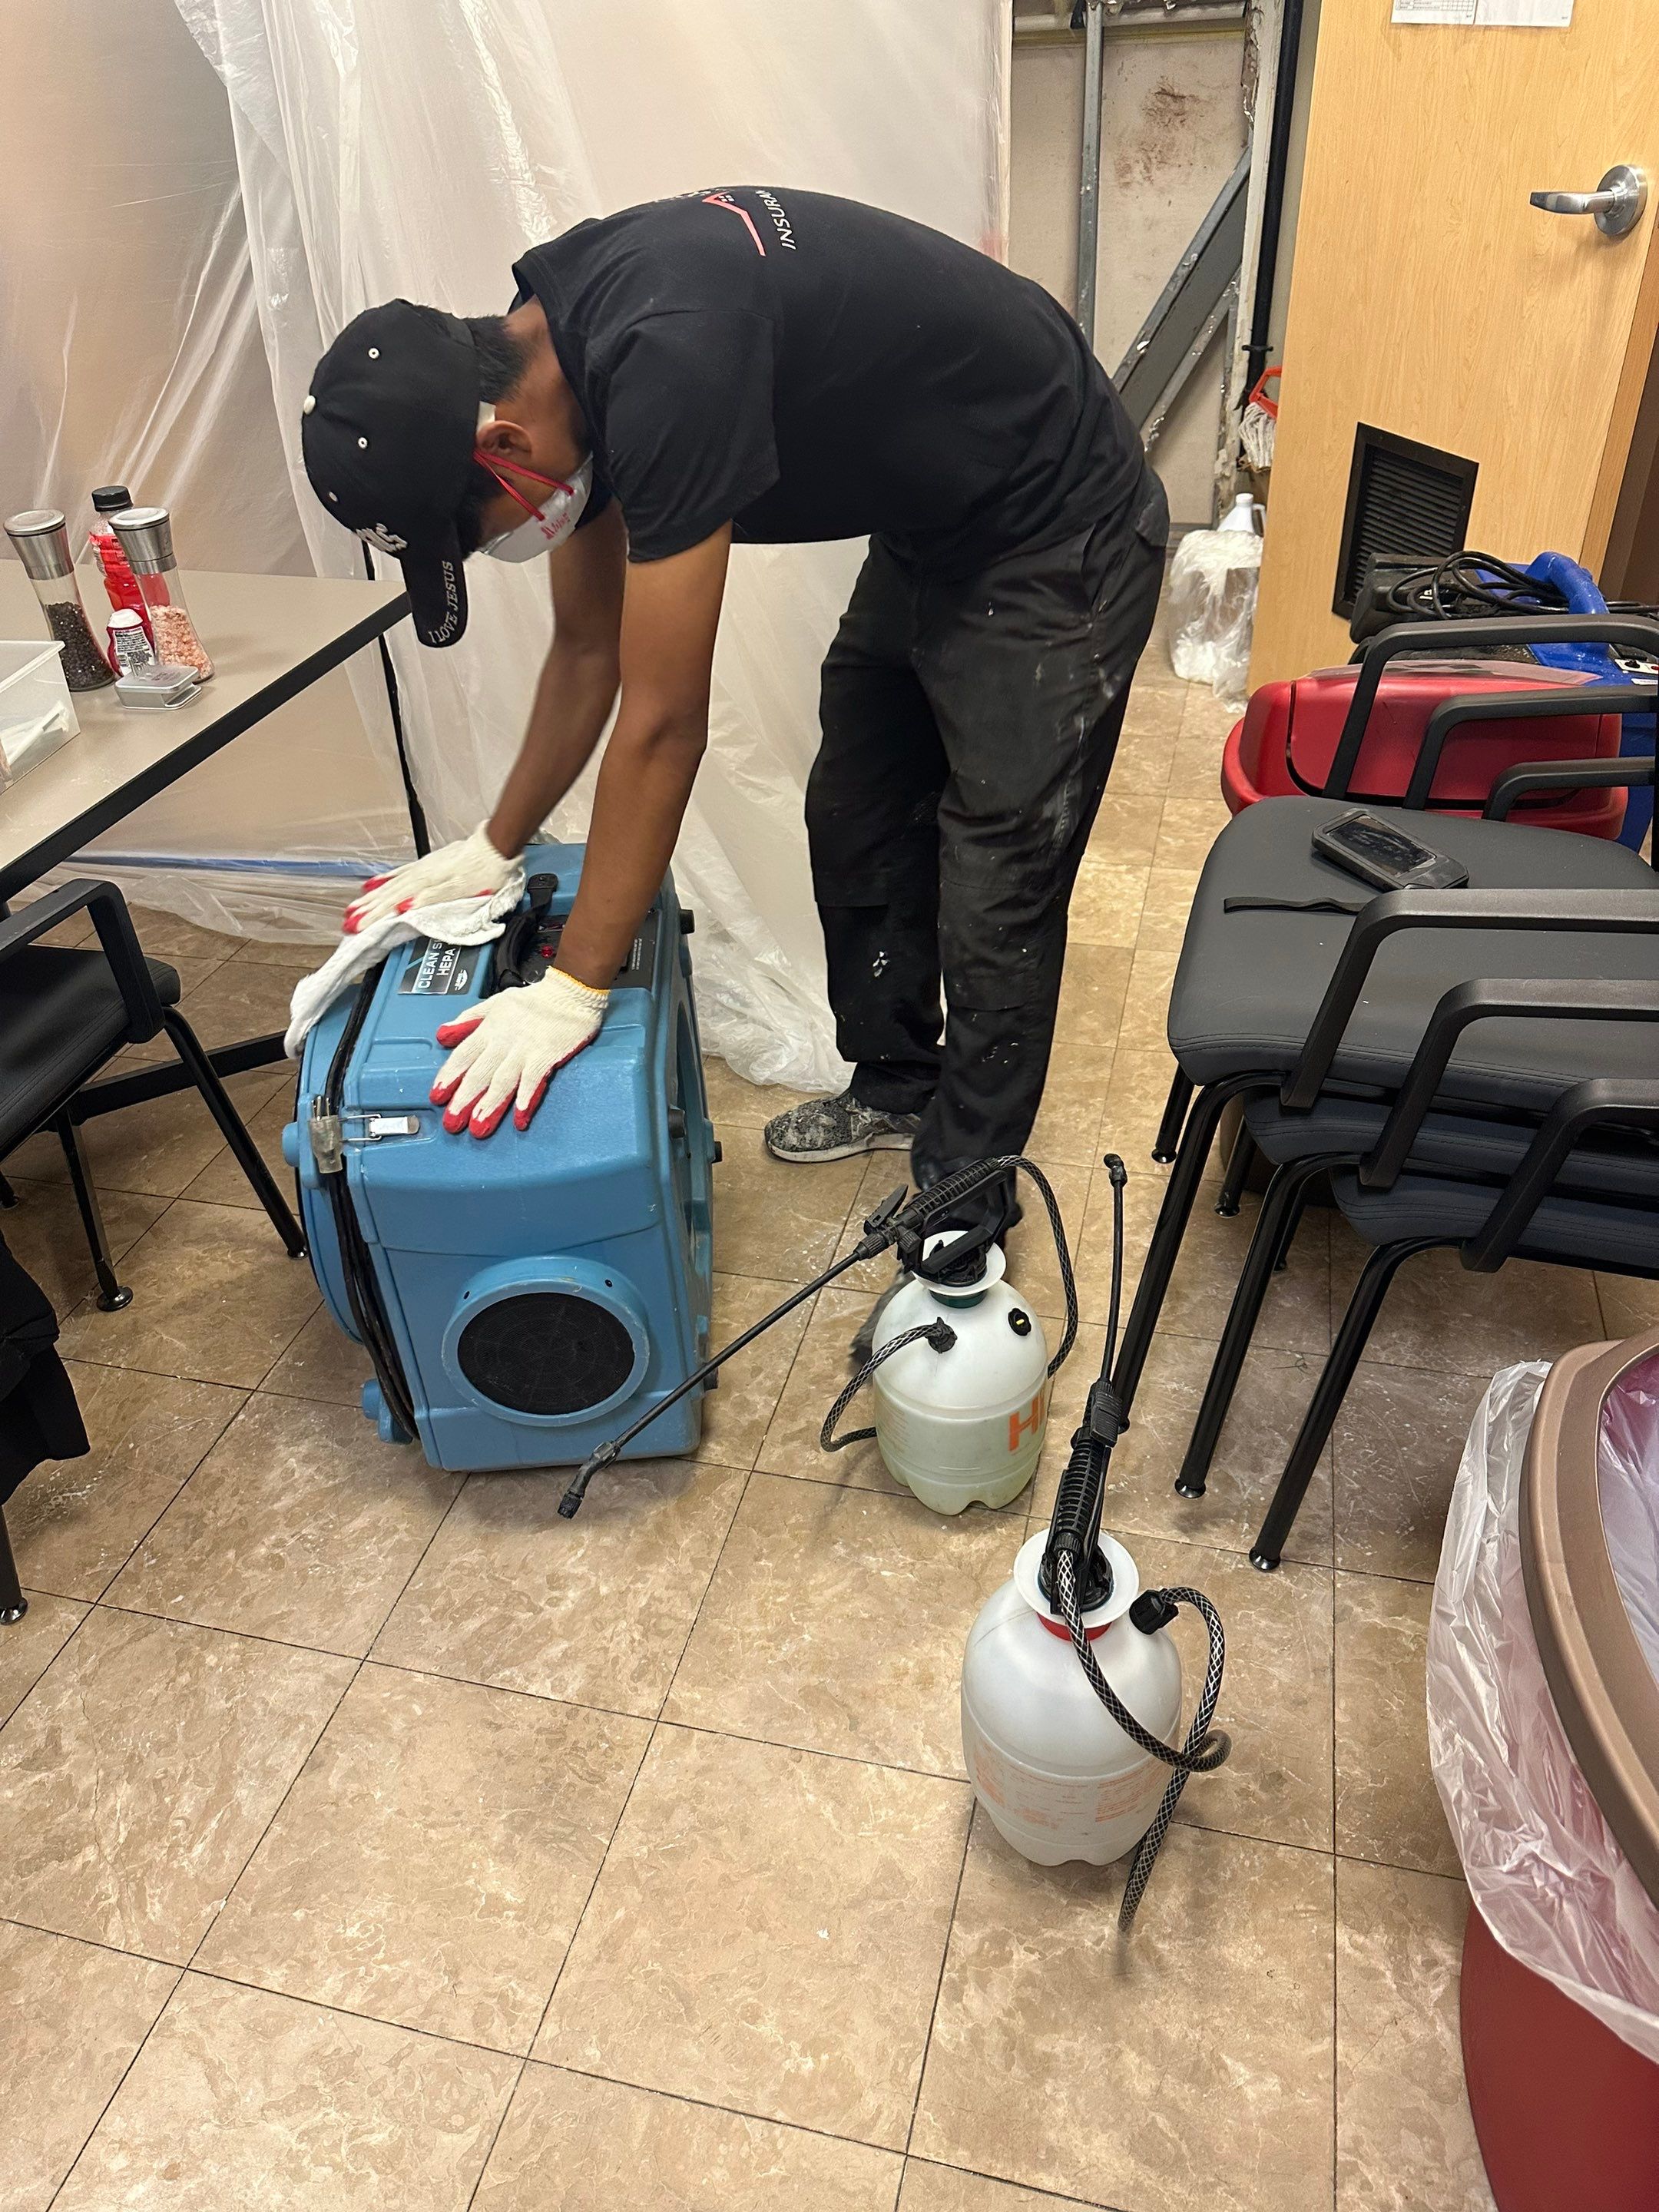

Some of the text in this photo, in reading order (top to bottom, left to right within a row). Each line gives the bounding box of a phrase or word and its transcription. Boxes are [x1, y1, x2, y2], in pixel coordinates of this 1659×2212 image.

[442, 560, 459, 612] JESUS
[434, 611, 458, 643] LOVE
[417, 952, 440, 988] CLEAN
[435, 948, 456, 975] HEPA
